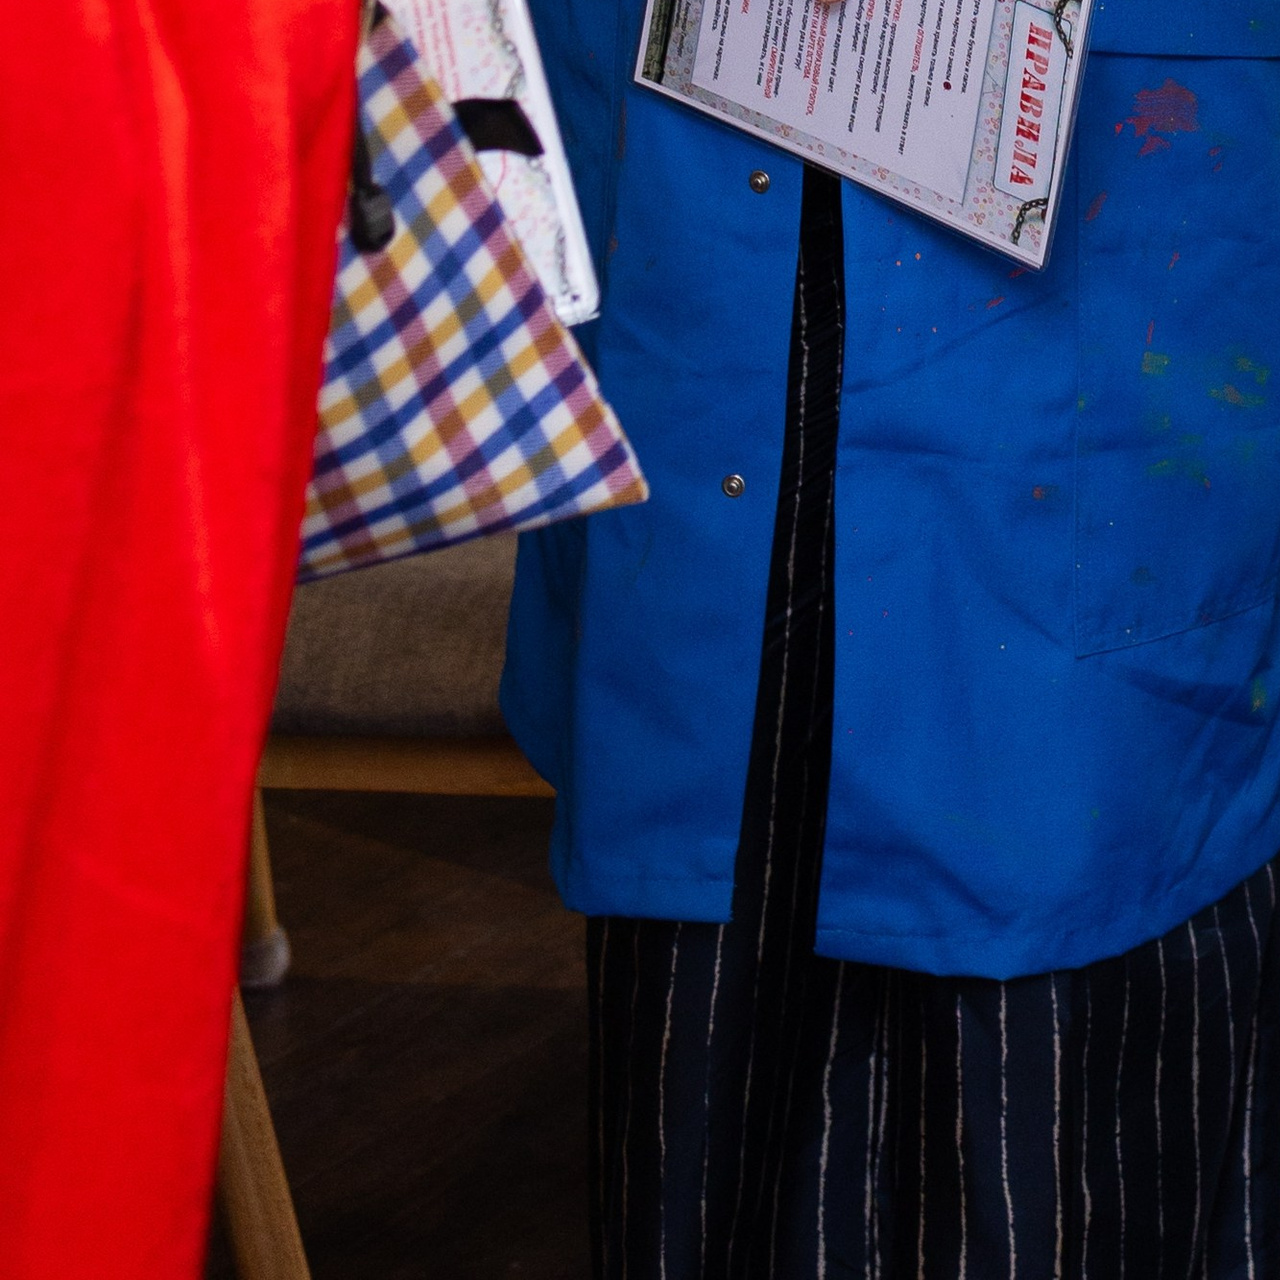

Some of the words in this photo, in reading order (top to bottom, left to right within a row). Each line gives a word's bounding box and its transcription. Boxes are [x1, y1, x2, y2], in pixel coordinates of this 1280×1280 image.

[881, 15, 889, 29] обе
[950, 15, 960, 48] карточки
[798, 29, 806, 43] раз
[806, 28, 817, 51] КАРТЕ
[876, 28, 886, 61] карточки
[930, 29, 940, 57] хранить
[793, 51, 802, 70] игру!
[964, 38, 976, 67] буклеты
[926, 57, 936, 81] только
[944, 55, 954, 81] знаком
[853, 82, 861, 96] все
[1008, 21, 1053, 188] ПРАВИЛА
